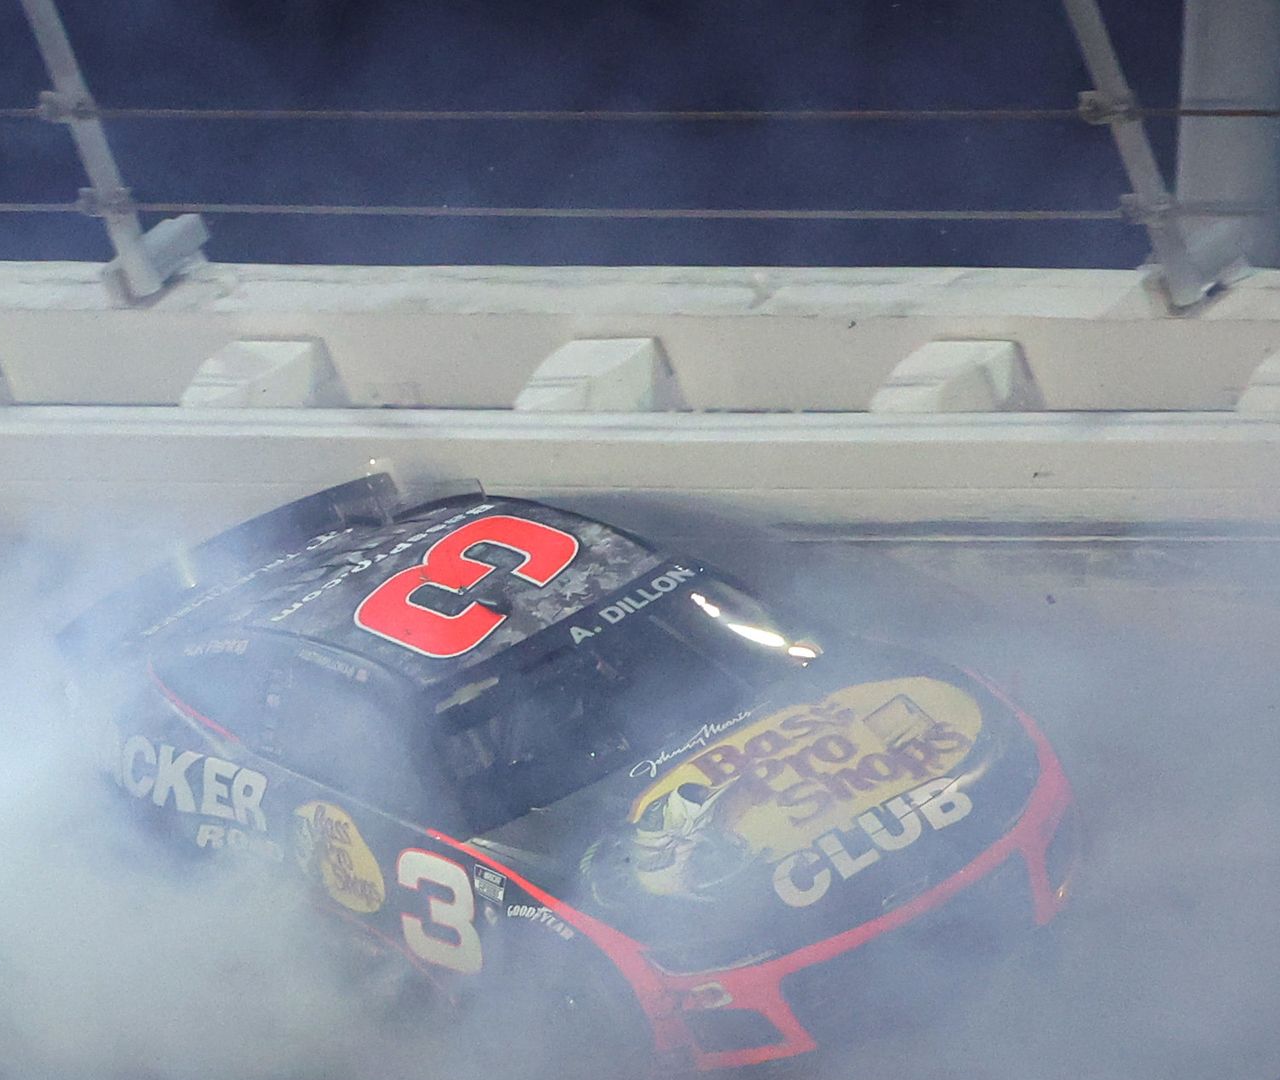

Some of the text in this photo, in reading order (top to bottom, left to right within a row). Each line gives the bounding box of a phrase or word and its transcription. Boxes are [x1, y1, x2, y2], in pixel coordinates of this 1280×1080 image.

[354, 514, 578, 658] 3
[570, 565, 695, 644] A. DILLON
[692, 703, 855, 786] Bass
[742, 733, 859, 796] Pro
[776, 721, 969, 827] Shops
[774, 774, 973, 907] CLUB
[397, 848, 484, 975] 3
